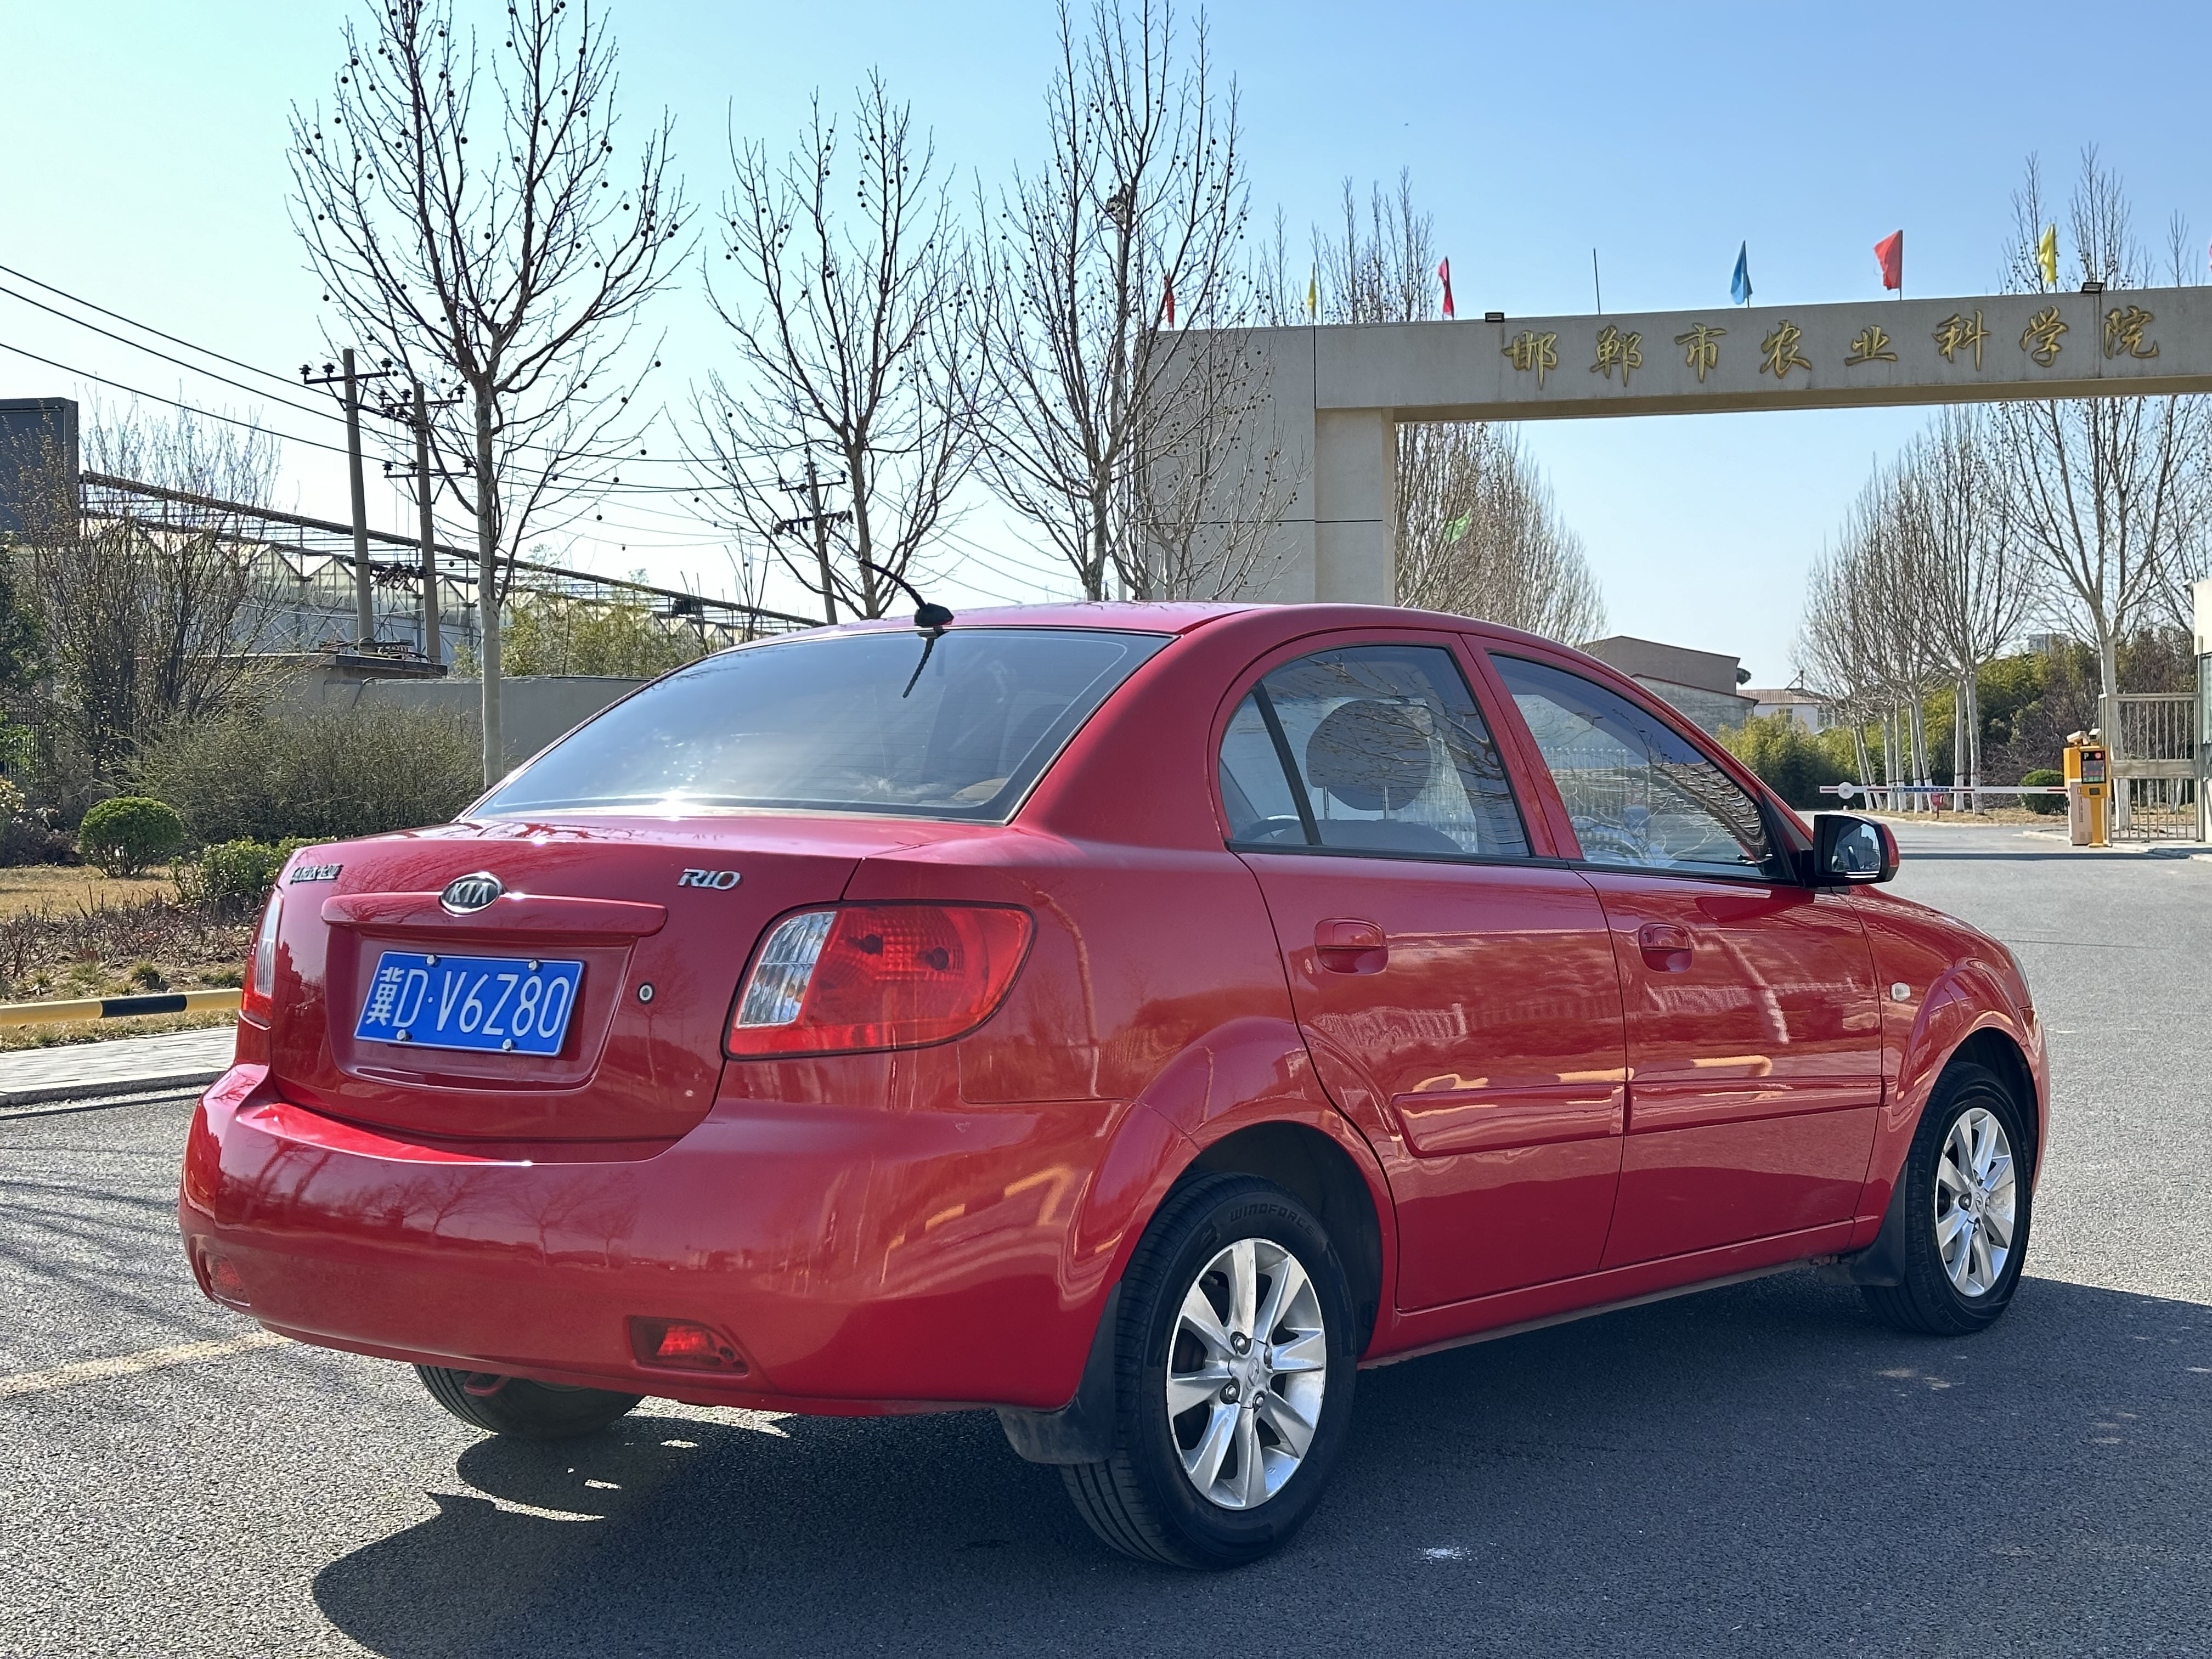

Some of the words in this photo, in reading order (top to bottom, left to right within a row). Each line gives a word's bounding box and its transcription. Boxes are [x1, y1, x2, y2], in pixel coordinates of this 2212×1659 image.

[1502, 305, 2159, 390] 邯郸市农业科学院
[449, 882, 490, 904] KIA
[677, 868, 741, 890] RIO
[366, 967, 570, 1038] 冀D·V6Z80
[1229, 1203, 1315, 1236] WINDFORCE
